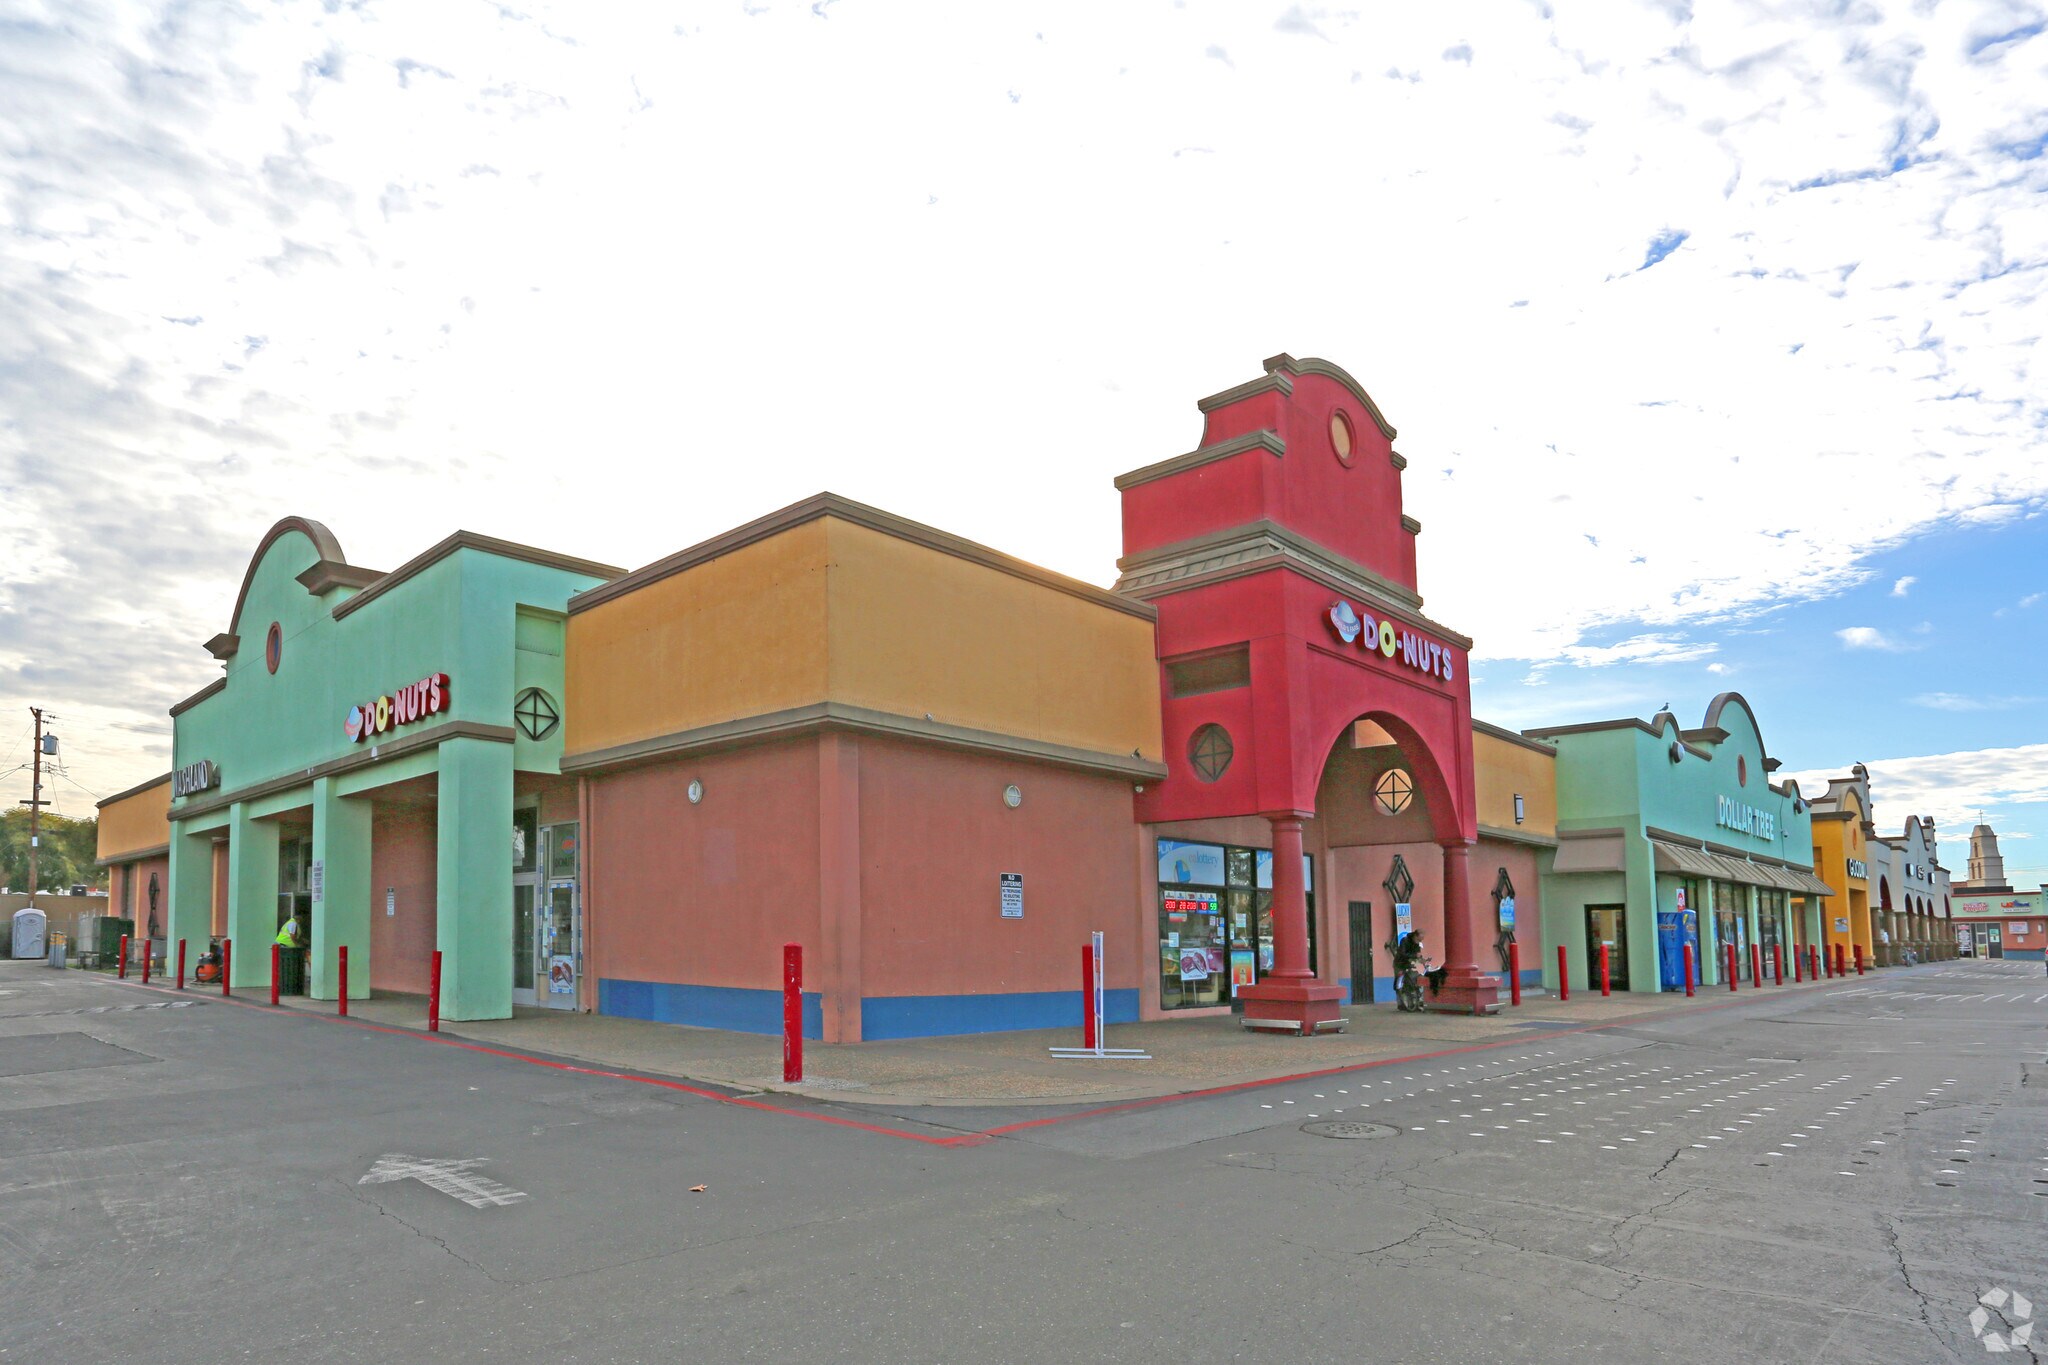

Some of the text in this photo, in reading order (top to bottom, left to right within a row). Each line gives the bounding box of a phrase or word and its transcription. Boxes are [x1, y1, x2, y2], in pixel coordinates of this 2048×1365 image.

[1363, 613, 1453, 681] DO-NUTS
[364, 672, 442, 737] DO-NUTS
[1719, 794, 1775, 841] DOLLAR TREE
